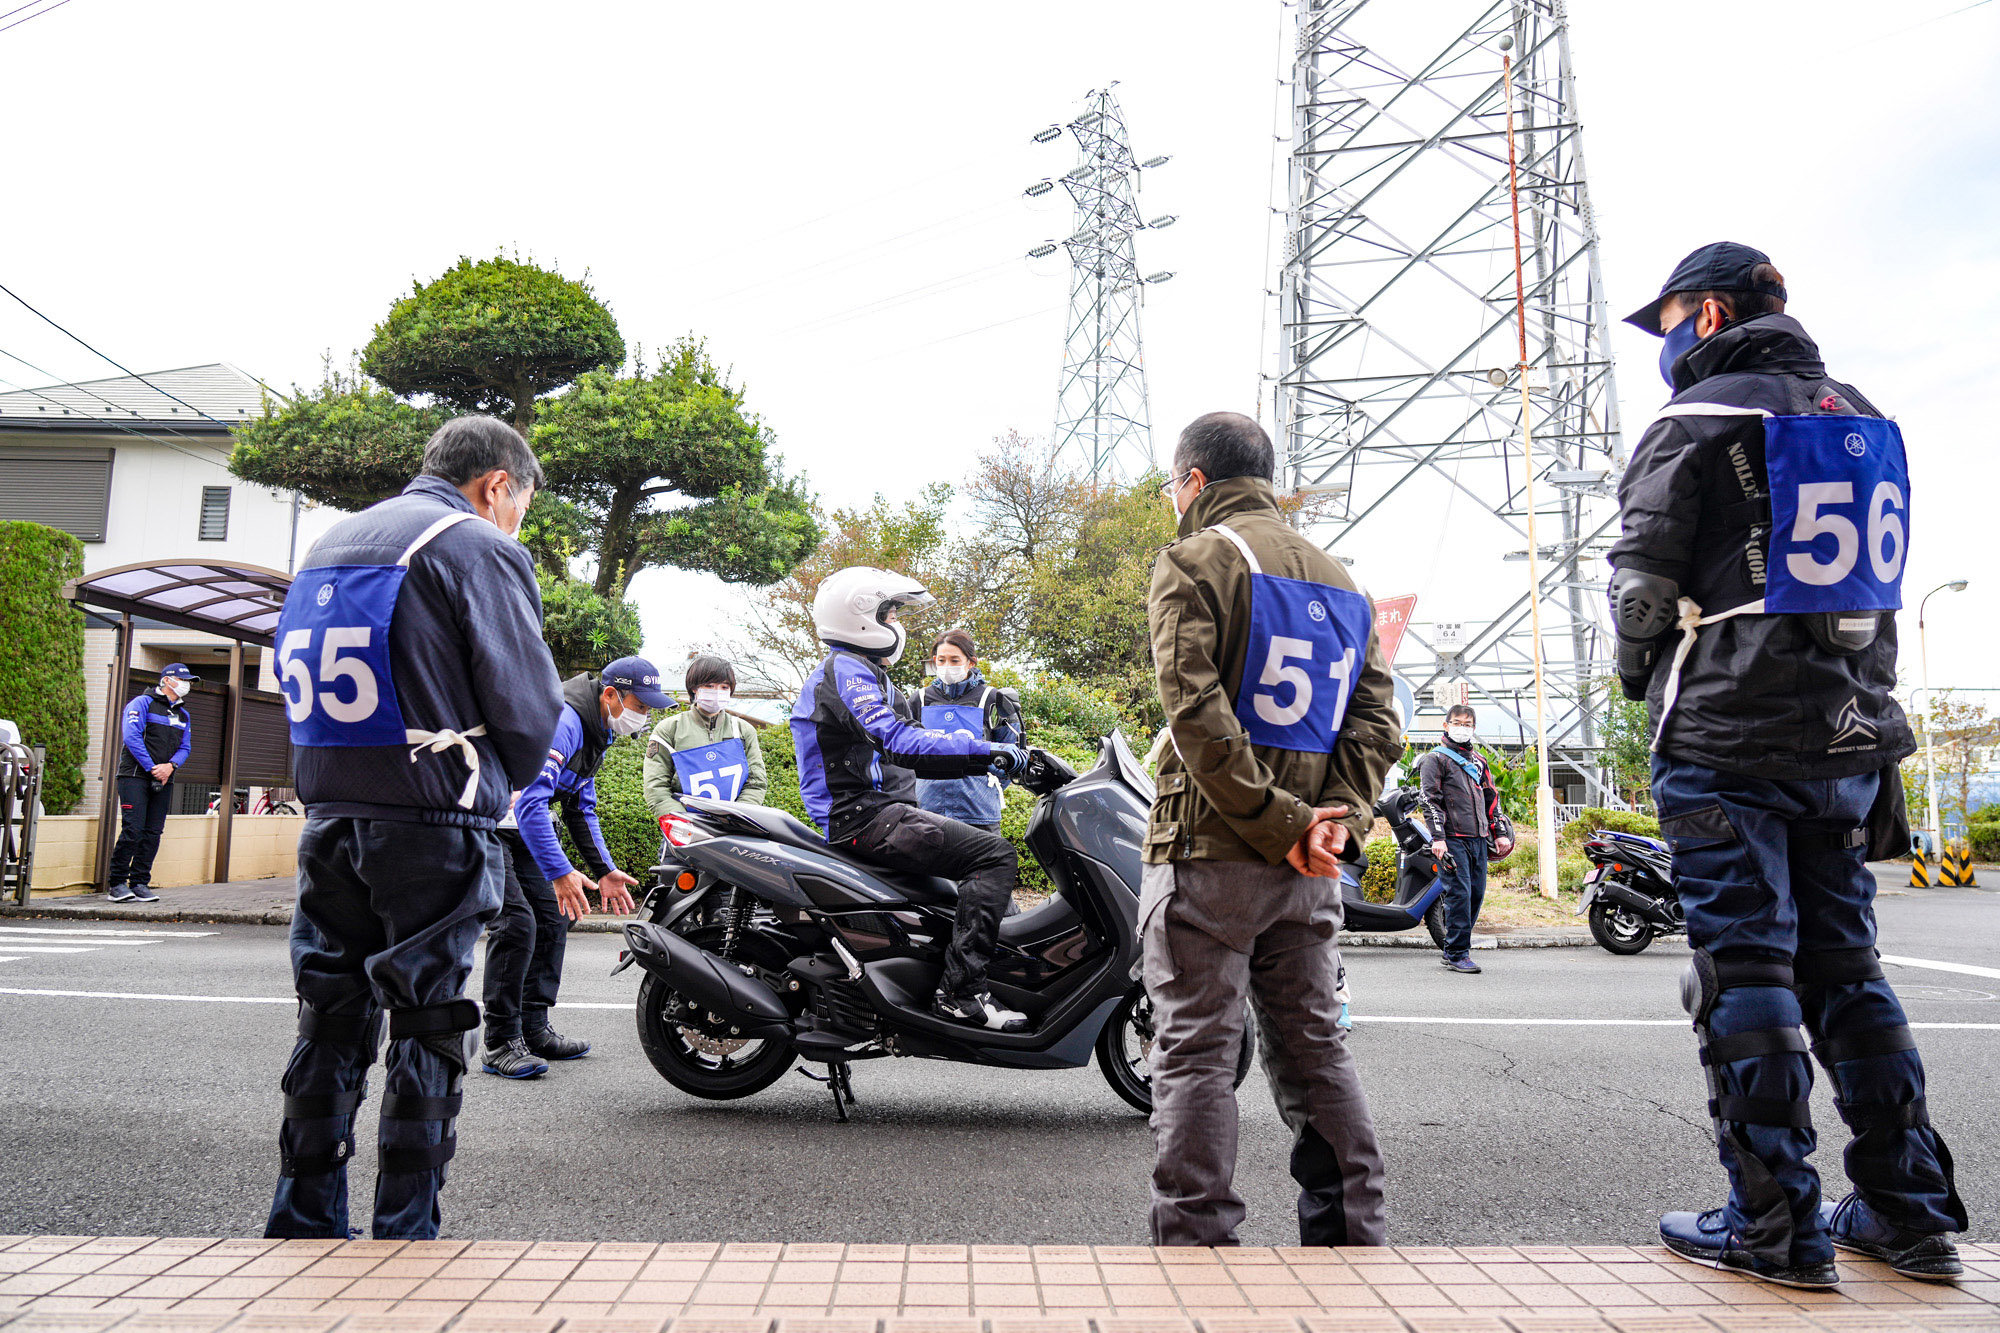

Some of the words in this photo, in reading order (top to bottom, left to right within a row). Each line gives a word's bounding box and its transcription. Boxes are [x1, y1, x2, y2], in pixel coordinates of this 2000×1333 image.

[1786, 481, 1904, 586] 56
[1375, 608, 1403, 626] まれ
[278, 627, 379, 723] 55
[1253, 635, 1356, 732] 51
[689, 763, 743, 802] 57
[729, 846, 781, 866] NMAX
